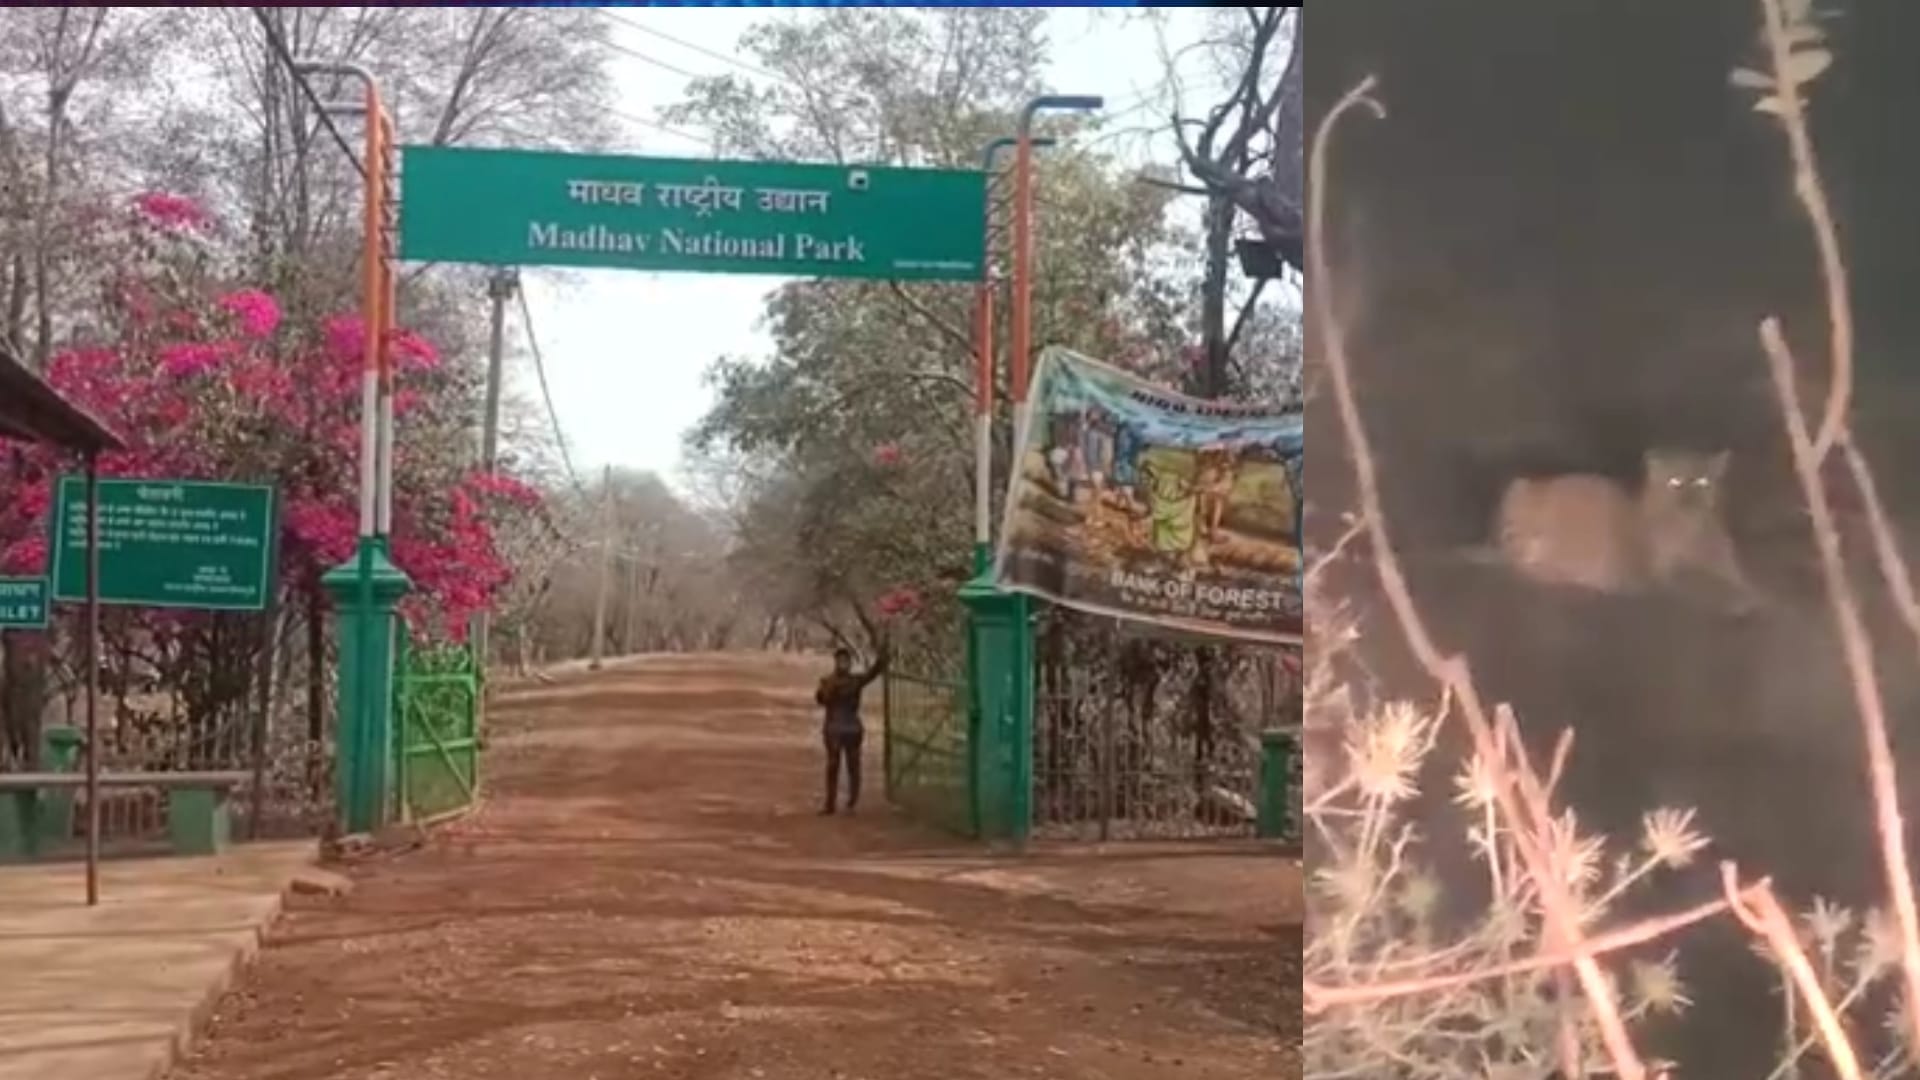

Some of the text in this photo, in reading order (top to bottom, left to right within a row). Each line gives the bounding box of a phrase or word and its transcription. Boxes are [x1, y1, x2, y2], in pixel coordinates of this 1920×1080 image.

[655, 175, 743, 216] राष्ट्रीय
[755, 188, 831, 213] उद्यान
[528, 221, 866, 264] Madhav National Park
[1111, 571, 1160, 594] BANK
[1164, 582, 1192, 601] OF
[1195, 587, 1284, 610] FOREST
